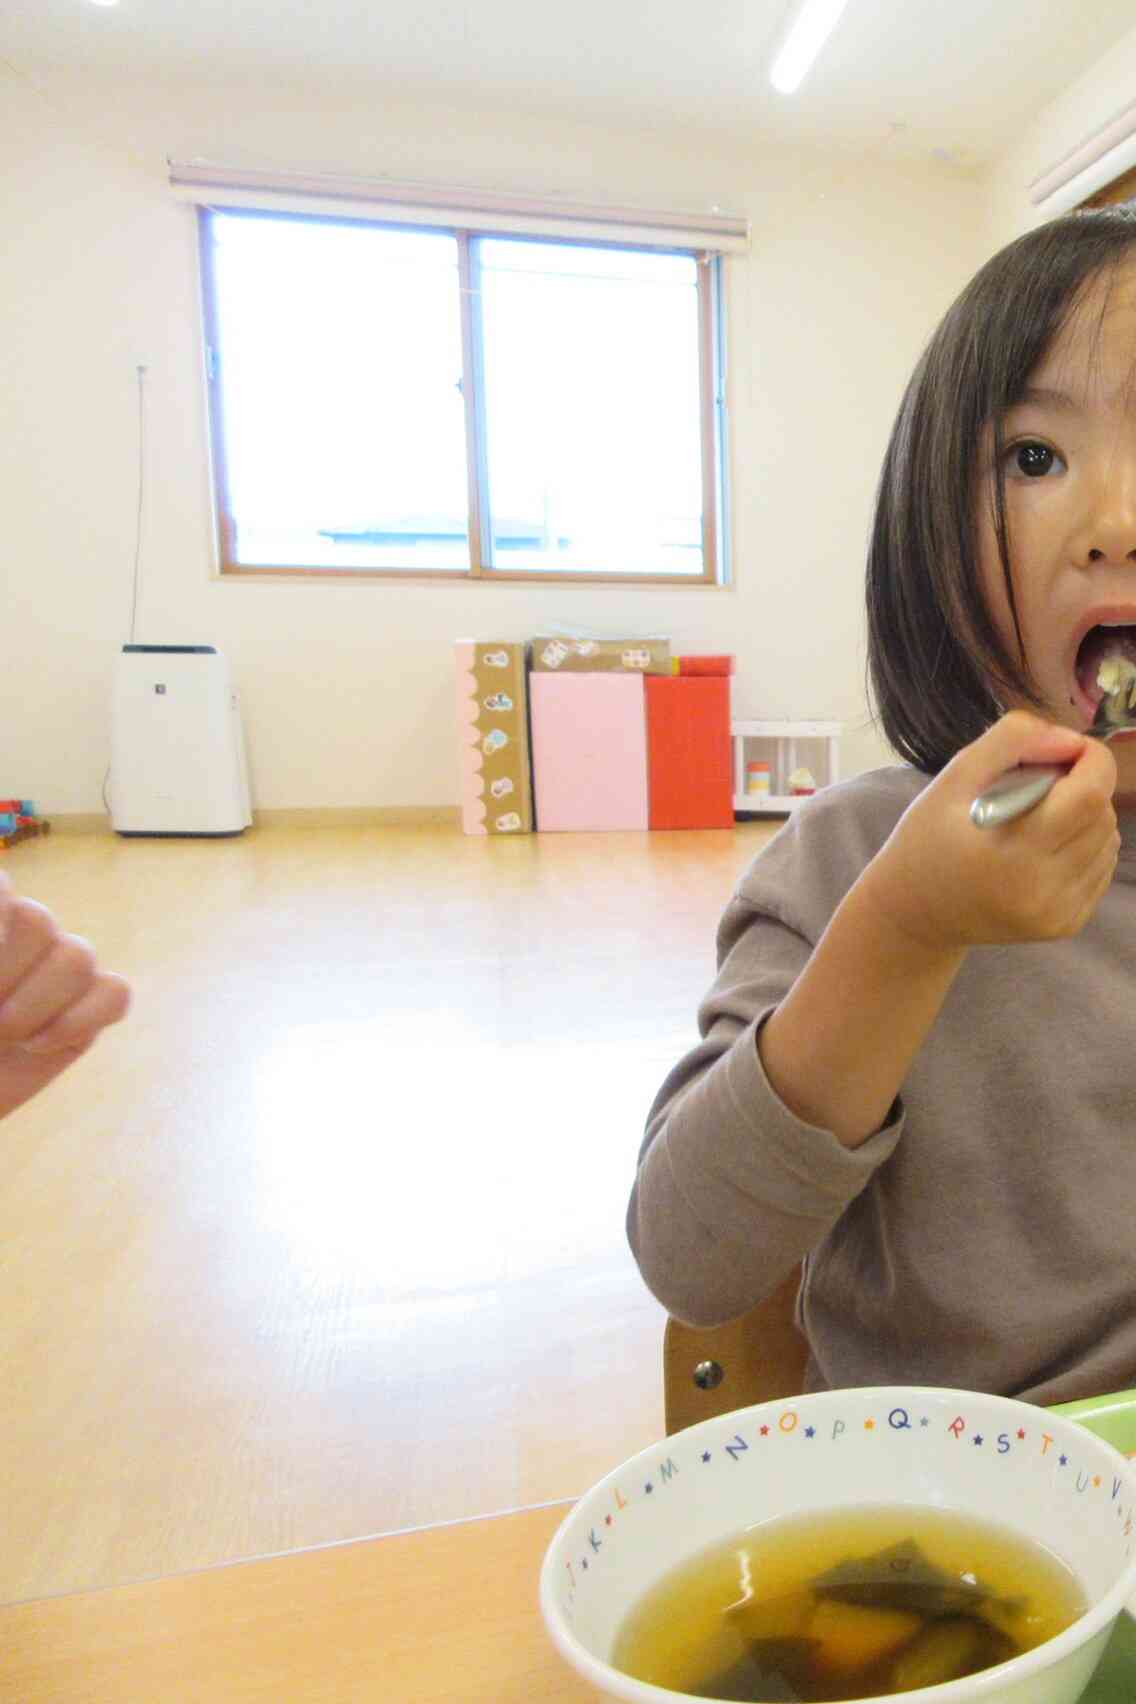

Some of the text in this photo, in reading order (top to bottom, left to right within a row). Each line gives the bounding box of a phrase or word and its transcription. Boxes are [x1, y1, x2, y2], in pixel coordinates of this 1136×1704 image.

[589, 1527, 602, 1552] K
[613, 1487, 627, 1510] L
[659, 1457, 679, 1484] M
[725, 1435, 749, 1461] N
[779, 1411, 798, 1433] O
[832, 1419, 846, 1440] P
[888, 1407, 912, 1430] Q
[948, 1416, 965, 1439] R
[997, 1433, 1011, 1454] S
[1041, 1432, 1054, 1456] T
[1076, 1471, 1089, 1493] U
[1111, 1476, 1122, 1500] V
